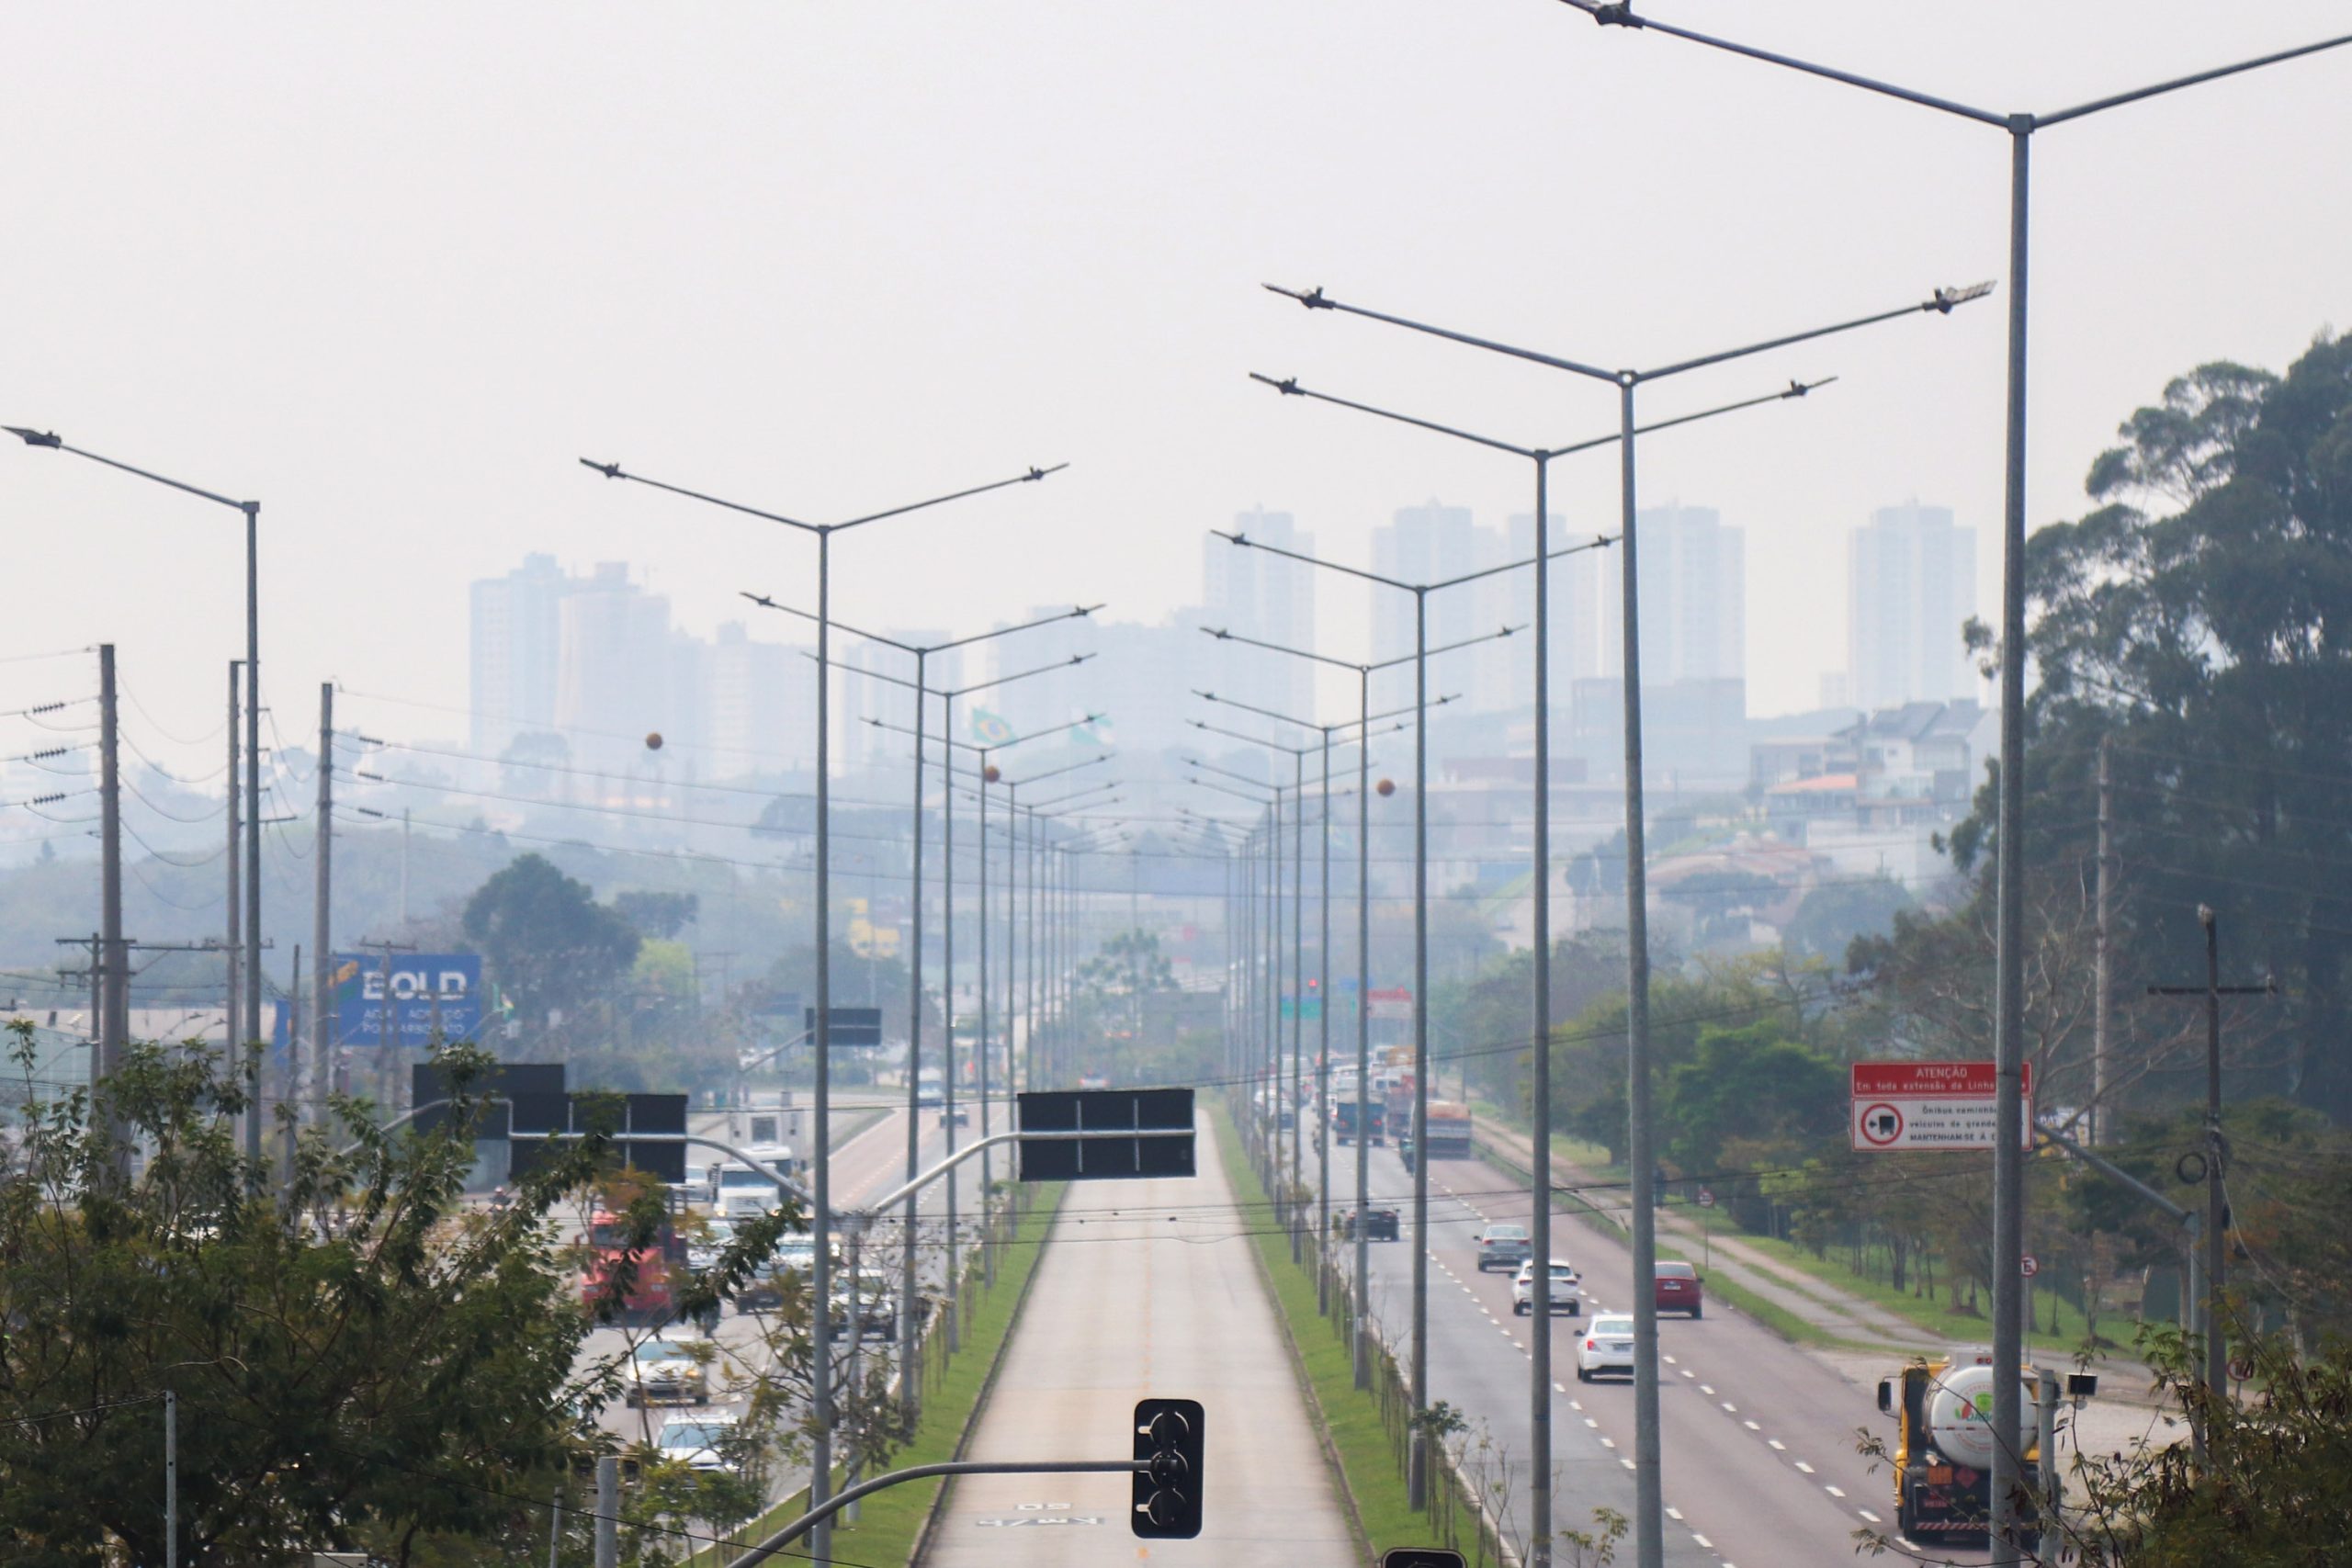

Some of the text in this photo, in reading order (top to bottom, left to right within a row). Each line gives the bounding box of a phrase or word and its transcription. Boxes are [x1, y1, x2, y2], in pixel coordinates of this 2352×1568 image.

[1917, 1066, 1968, 1080] ATENÇÃO
[1856, 1080, 1996, 1091] Em toda extensão da Linha
[1922, 1104, 1997, 1115] Ônibus caminhõ
[1950, 1119, 1961, 1128] de
